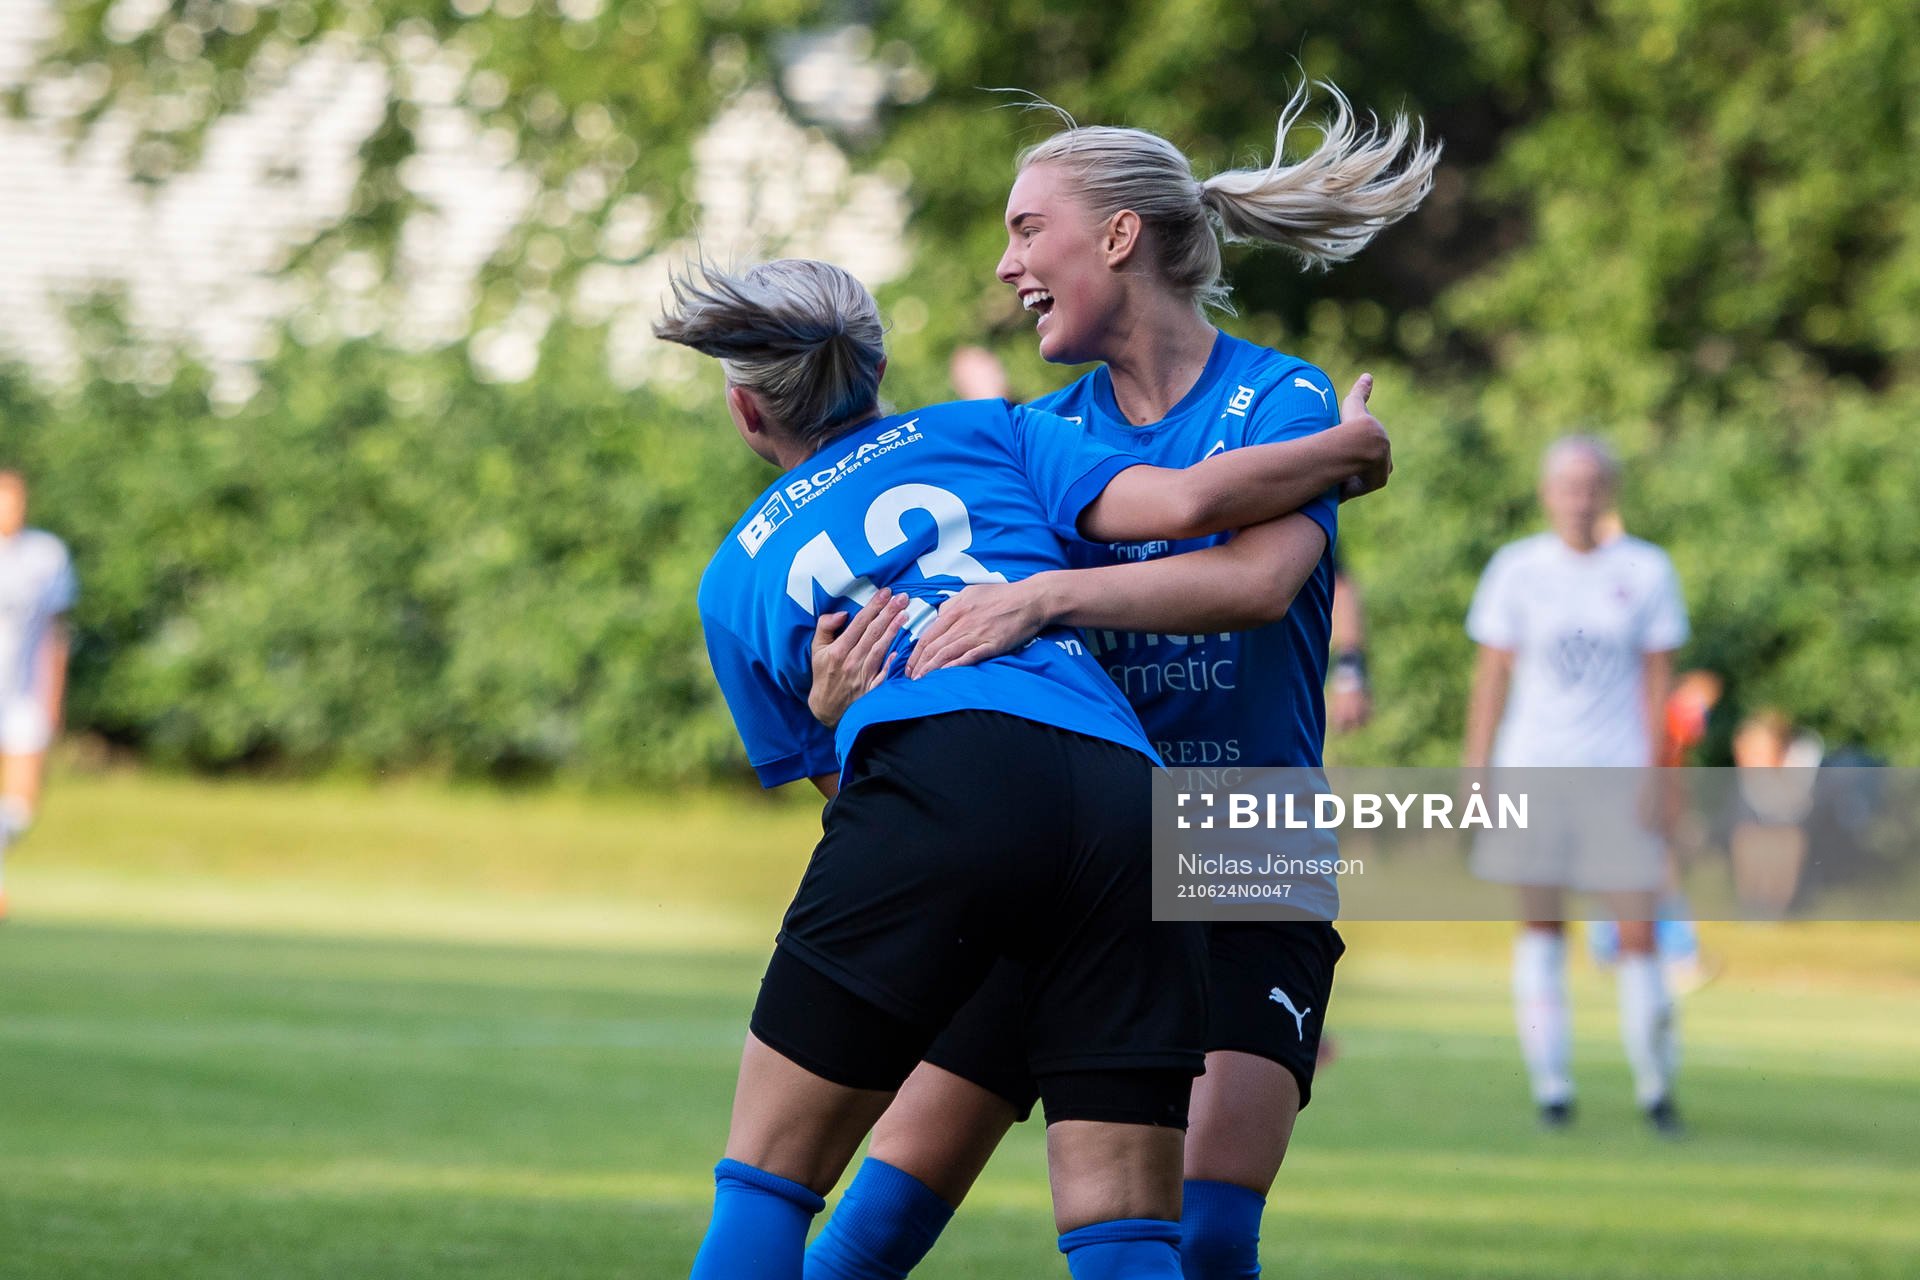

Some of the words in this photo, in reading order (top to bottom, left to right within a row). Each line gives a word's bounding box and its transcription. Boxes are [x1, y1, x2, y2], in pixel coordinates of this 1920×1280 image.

[785, 417, 920, 501] BOFAST
[872, 432, 924, 459] LOKALER
[737, 491, 793, 559] BF
[786, 483, 1009, 641] 13
[1156, 739, 1241, 763] REDS
